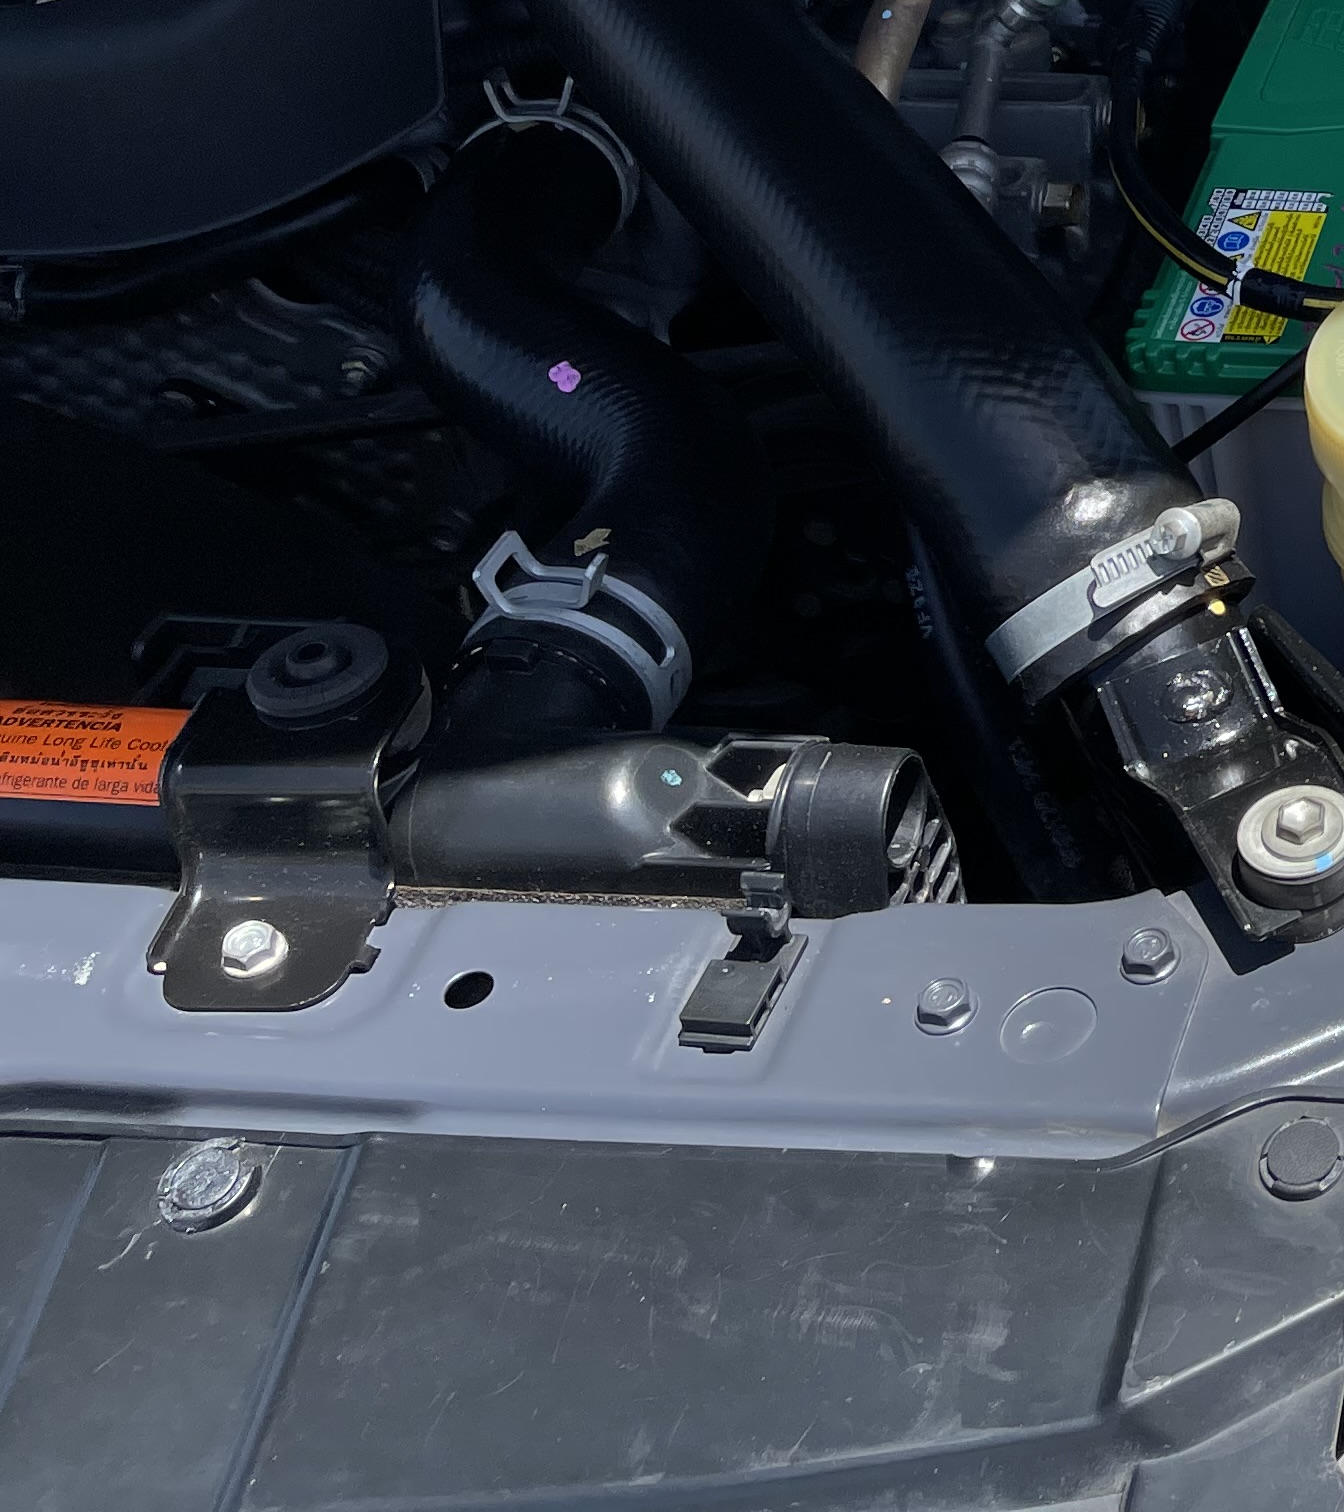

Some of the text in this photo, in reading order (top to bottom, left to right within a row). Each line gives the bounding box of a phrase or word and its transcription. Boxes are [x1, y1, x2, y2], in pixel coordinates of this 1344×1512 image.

[42, 733, 87, 751] Long
[89, 735, 122, 751] Life
[72, 775, 90, 791] de
[93, 776, 129, 796] larga
